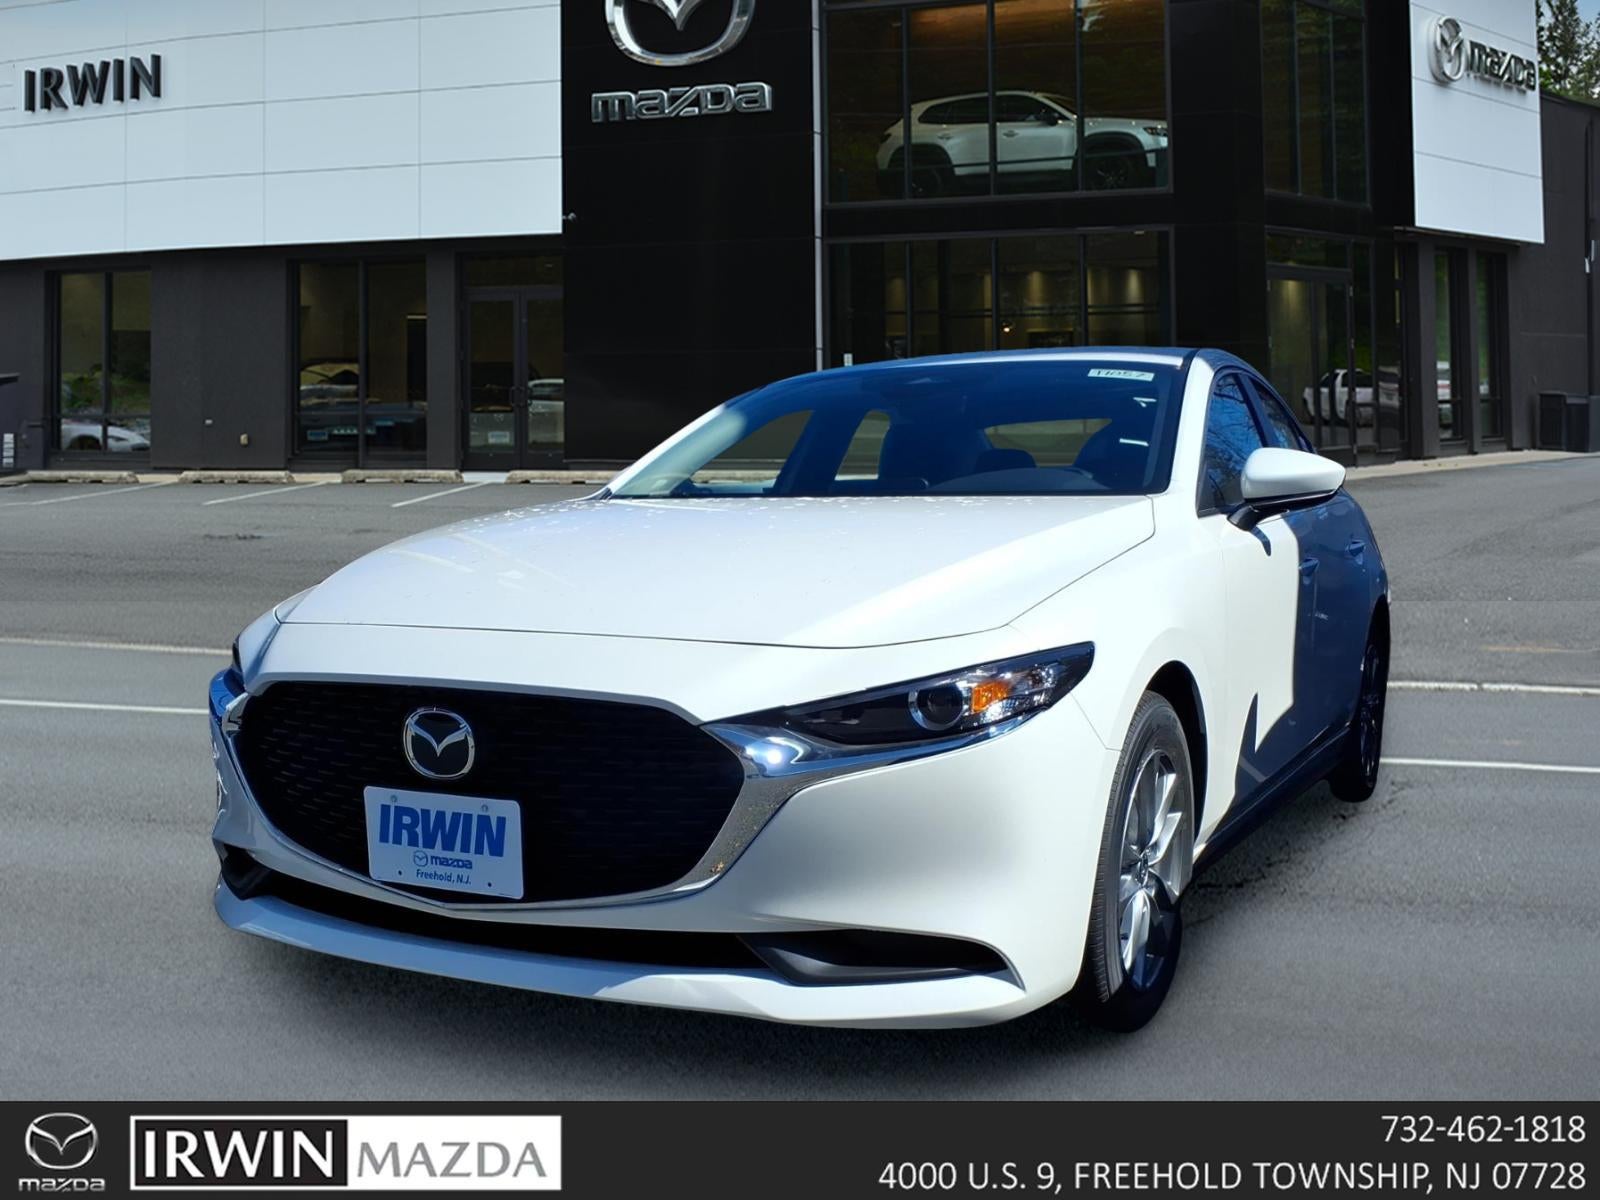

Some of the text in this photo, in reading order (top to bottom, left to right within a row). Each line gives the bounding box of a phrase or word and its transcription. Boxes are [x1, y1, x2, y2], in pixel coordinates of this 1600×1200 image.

[24, 53, 161, 112] IRWIN
[379, 804, 506, 857] IRWIN
[416, 869, 472, 885] Freehold, N.J.
